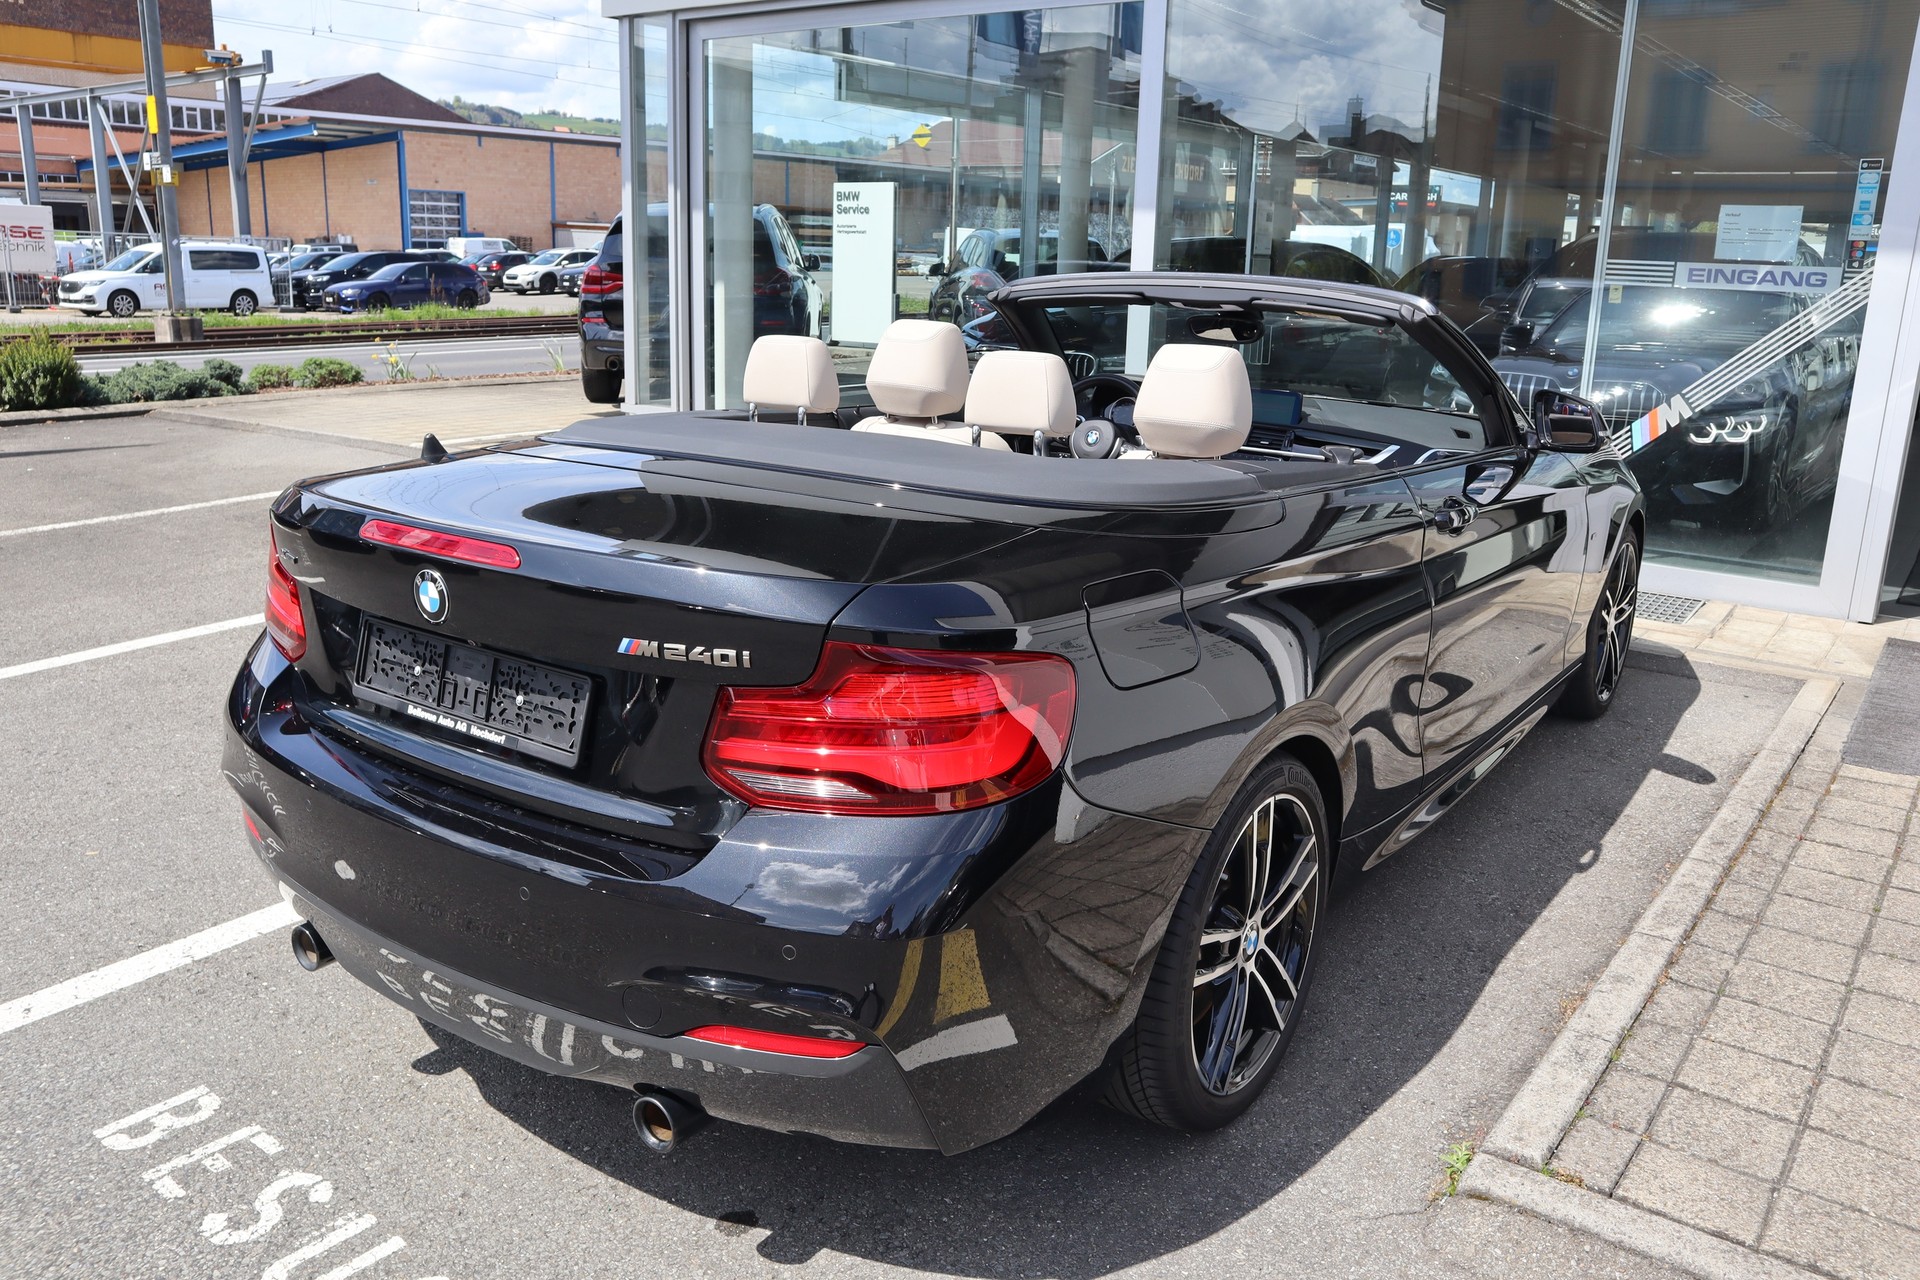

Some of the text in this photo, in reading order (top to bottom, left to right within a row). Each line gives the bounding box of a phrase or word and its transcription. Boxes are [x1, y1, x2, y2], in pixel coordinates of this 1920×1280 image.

[836, 191, 860, 202] BMW
[836, 203, 870, 215] Service
[1686, 267, 1828, 288] EINGANG
[1657, 394, 1693, 435] M
[416, 571, 443, 591] BMW
[407, 704, 506, 744] Bellevue Auto AG Hochdorf
